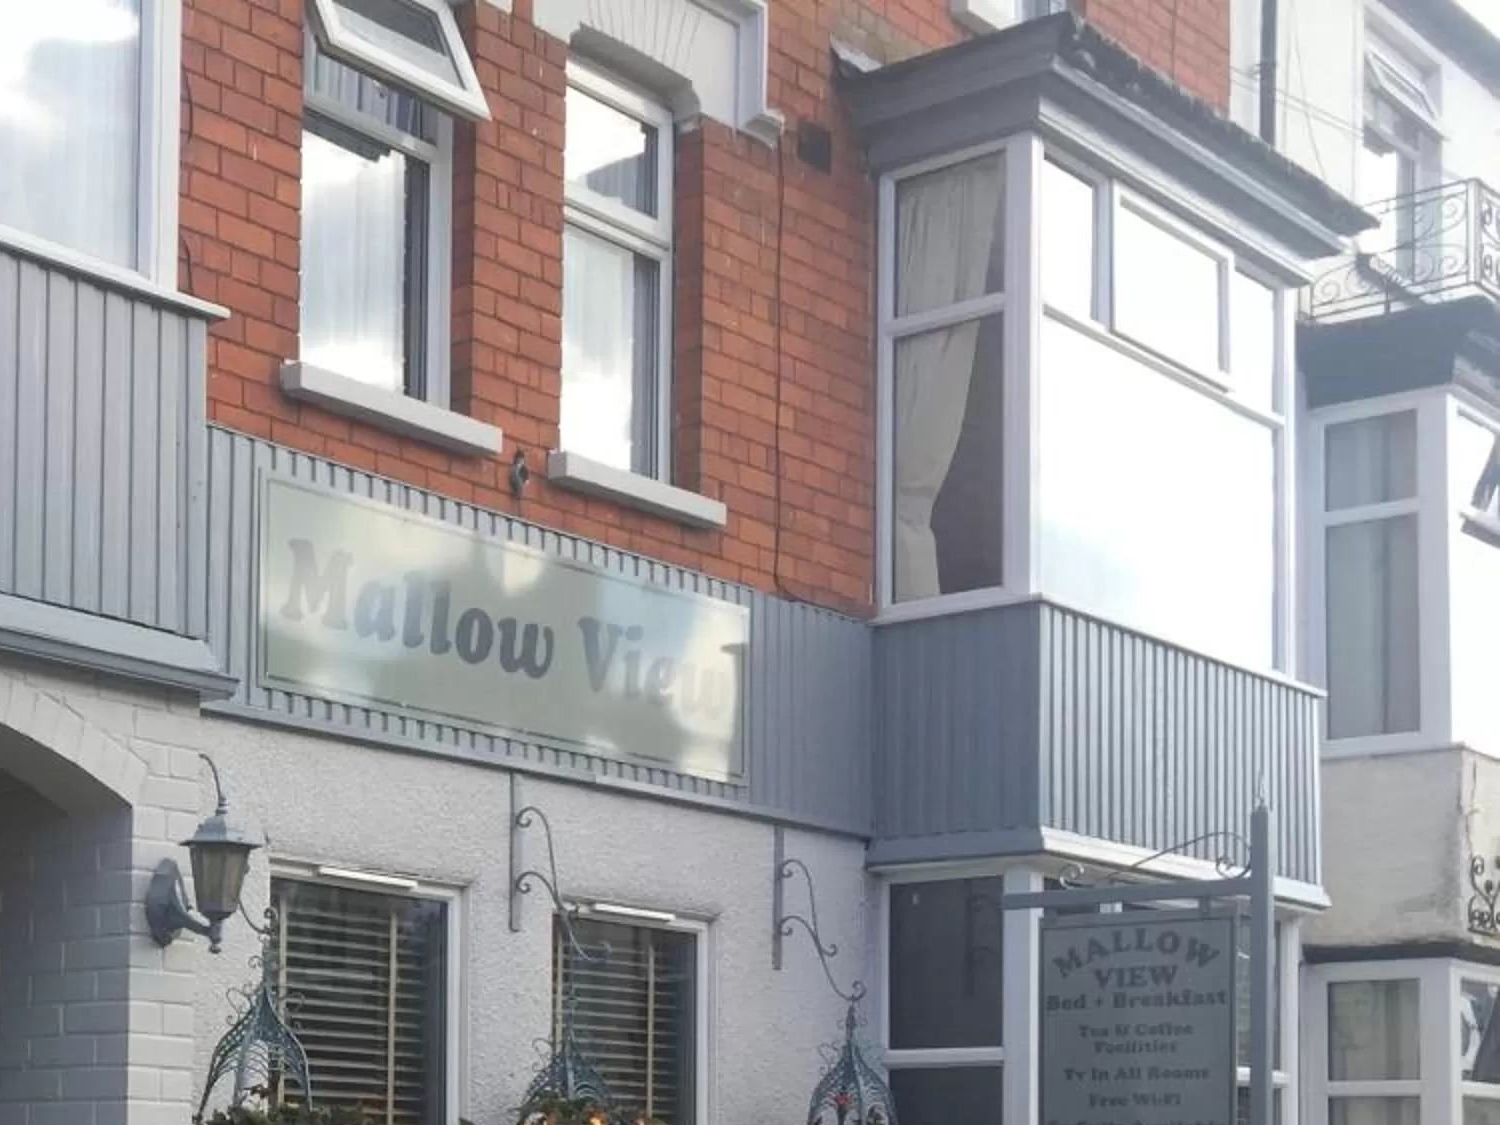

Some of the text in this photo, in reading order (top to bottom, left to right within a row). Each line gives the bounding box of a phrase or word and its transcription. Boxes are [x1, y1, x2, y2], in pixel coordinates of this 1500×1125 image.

[280, 538, 728, 722] Mallow View
[1051, 927, 1221, 978] MALLOW
[1095, 965, 1178, 990] VIEW
[1046, 994, 1087, 1011] Bed
[1113, 989, 1228, 1009] Breakfast
[1078, 1023, 1109, 1039] Tea
[1135, 1021, 1194, 1037] Coffee
[1094, 1039, 1177, 1054] Facilities
[1114, 1065, 1142, 1080] All
[1148, 1065, 1211, 1080] Rooms
[1088, 1092, 1129, 1108] Free
